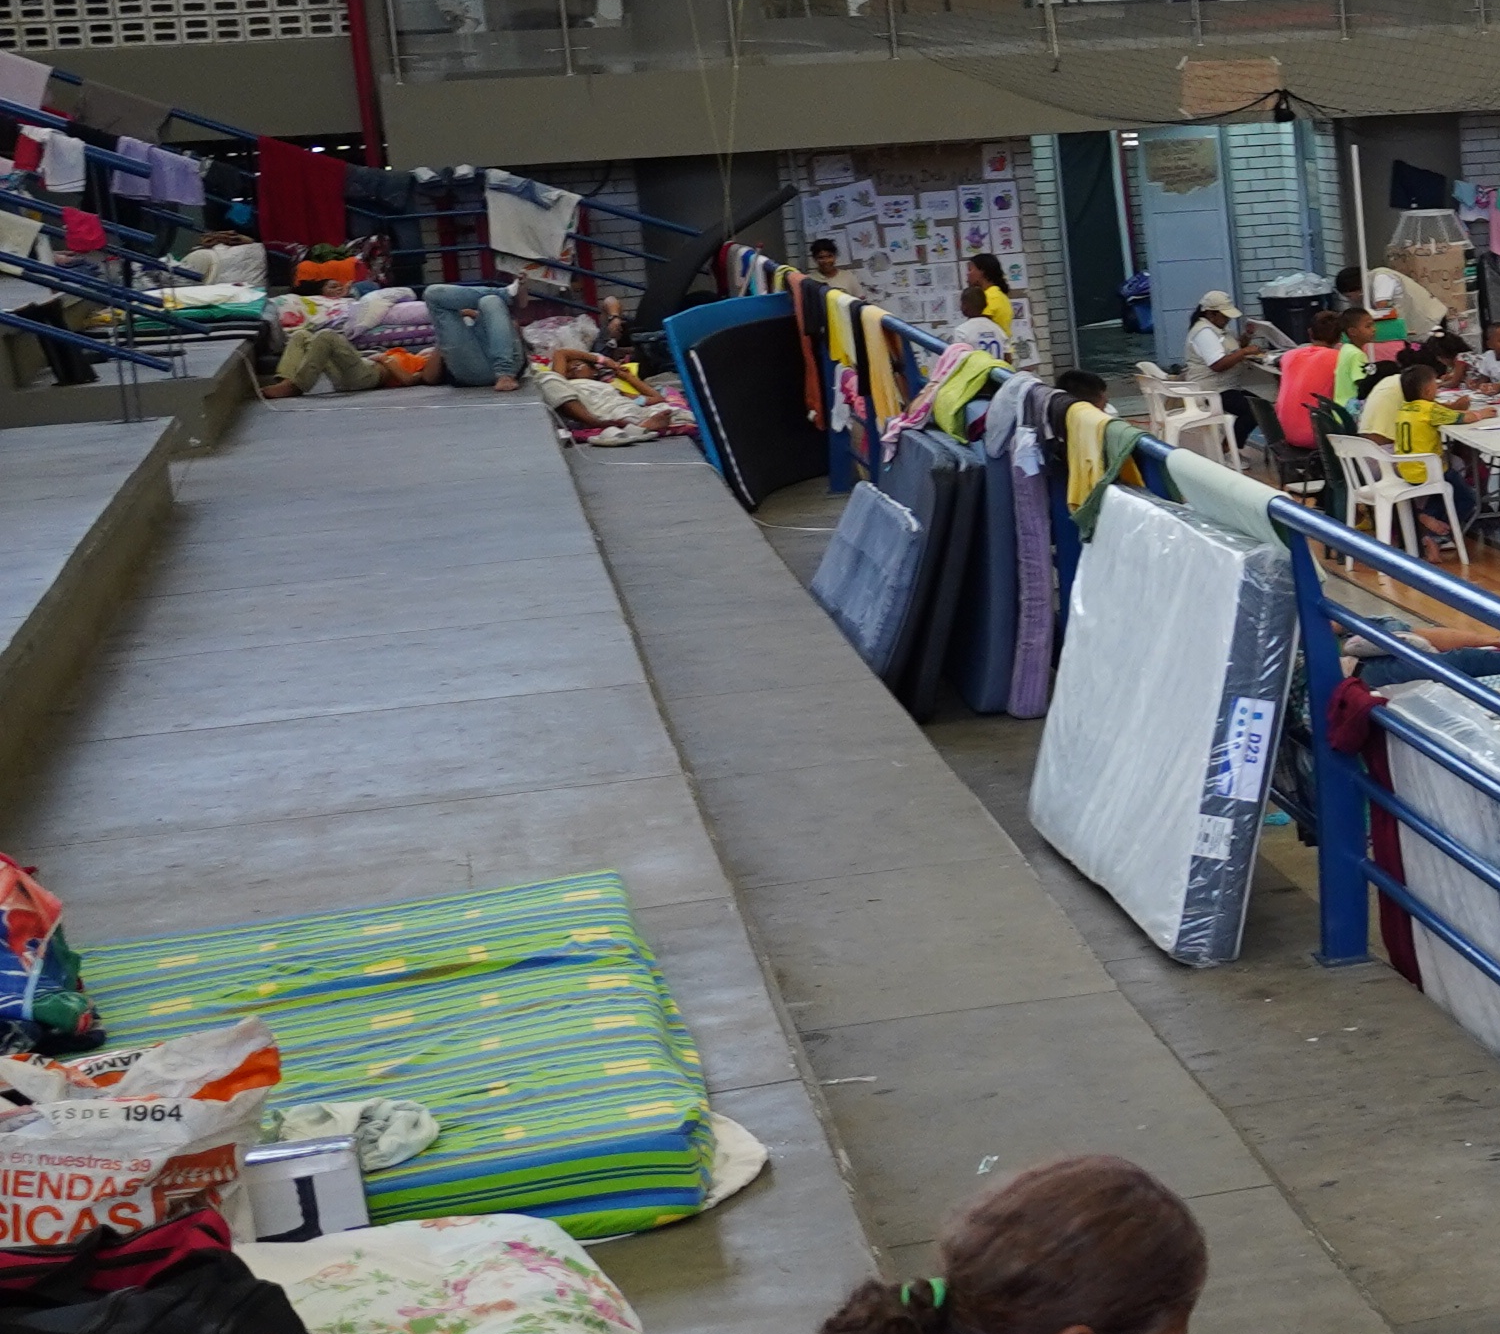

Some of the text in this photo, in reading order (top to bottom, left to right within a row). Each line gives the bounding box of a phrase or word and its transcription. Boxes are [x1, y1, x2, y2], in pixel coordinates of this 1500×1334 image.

[122, 1104, 183, 1122] 1964
[38, 1154, 122, 1170] nuestras
[127, 1158, 152, 1173] 39
